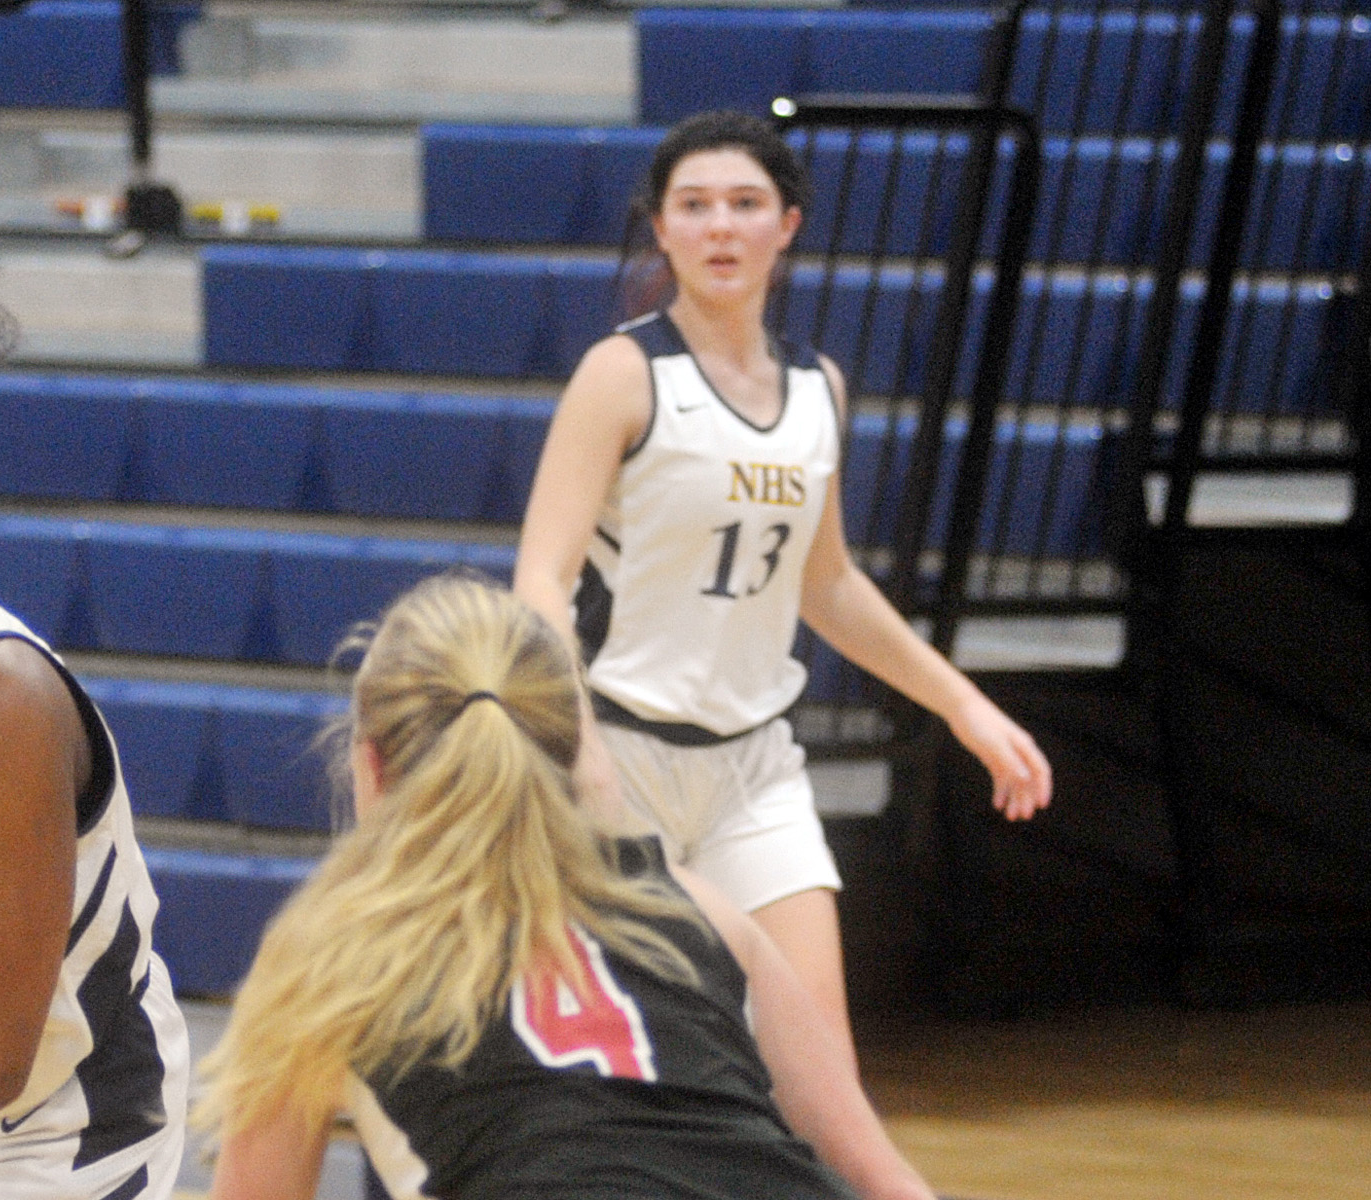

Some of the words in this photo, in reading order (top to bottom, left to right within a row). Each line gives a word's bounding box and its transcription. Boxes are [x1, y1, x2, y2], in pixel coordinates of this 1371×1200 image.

[725, 461, 807, 507] NHS
[699, 519, 791, 600] 13
[510, 916, 658, 1083] 4
